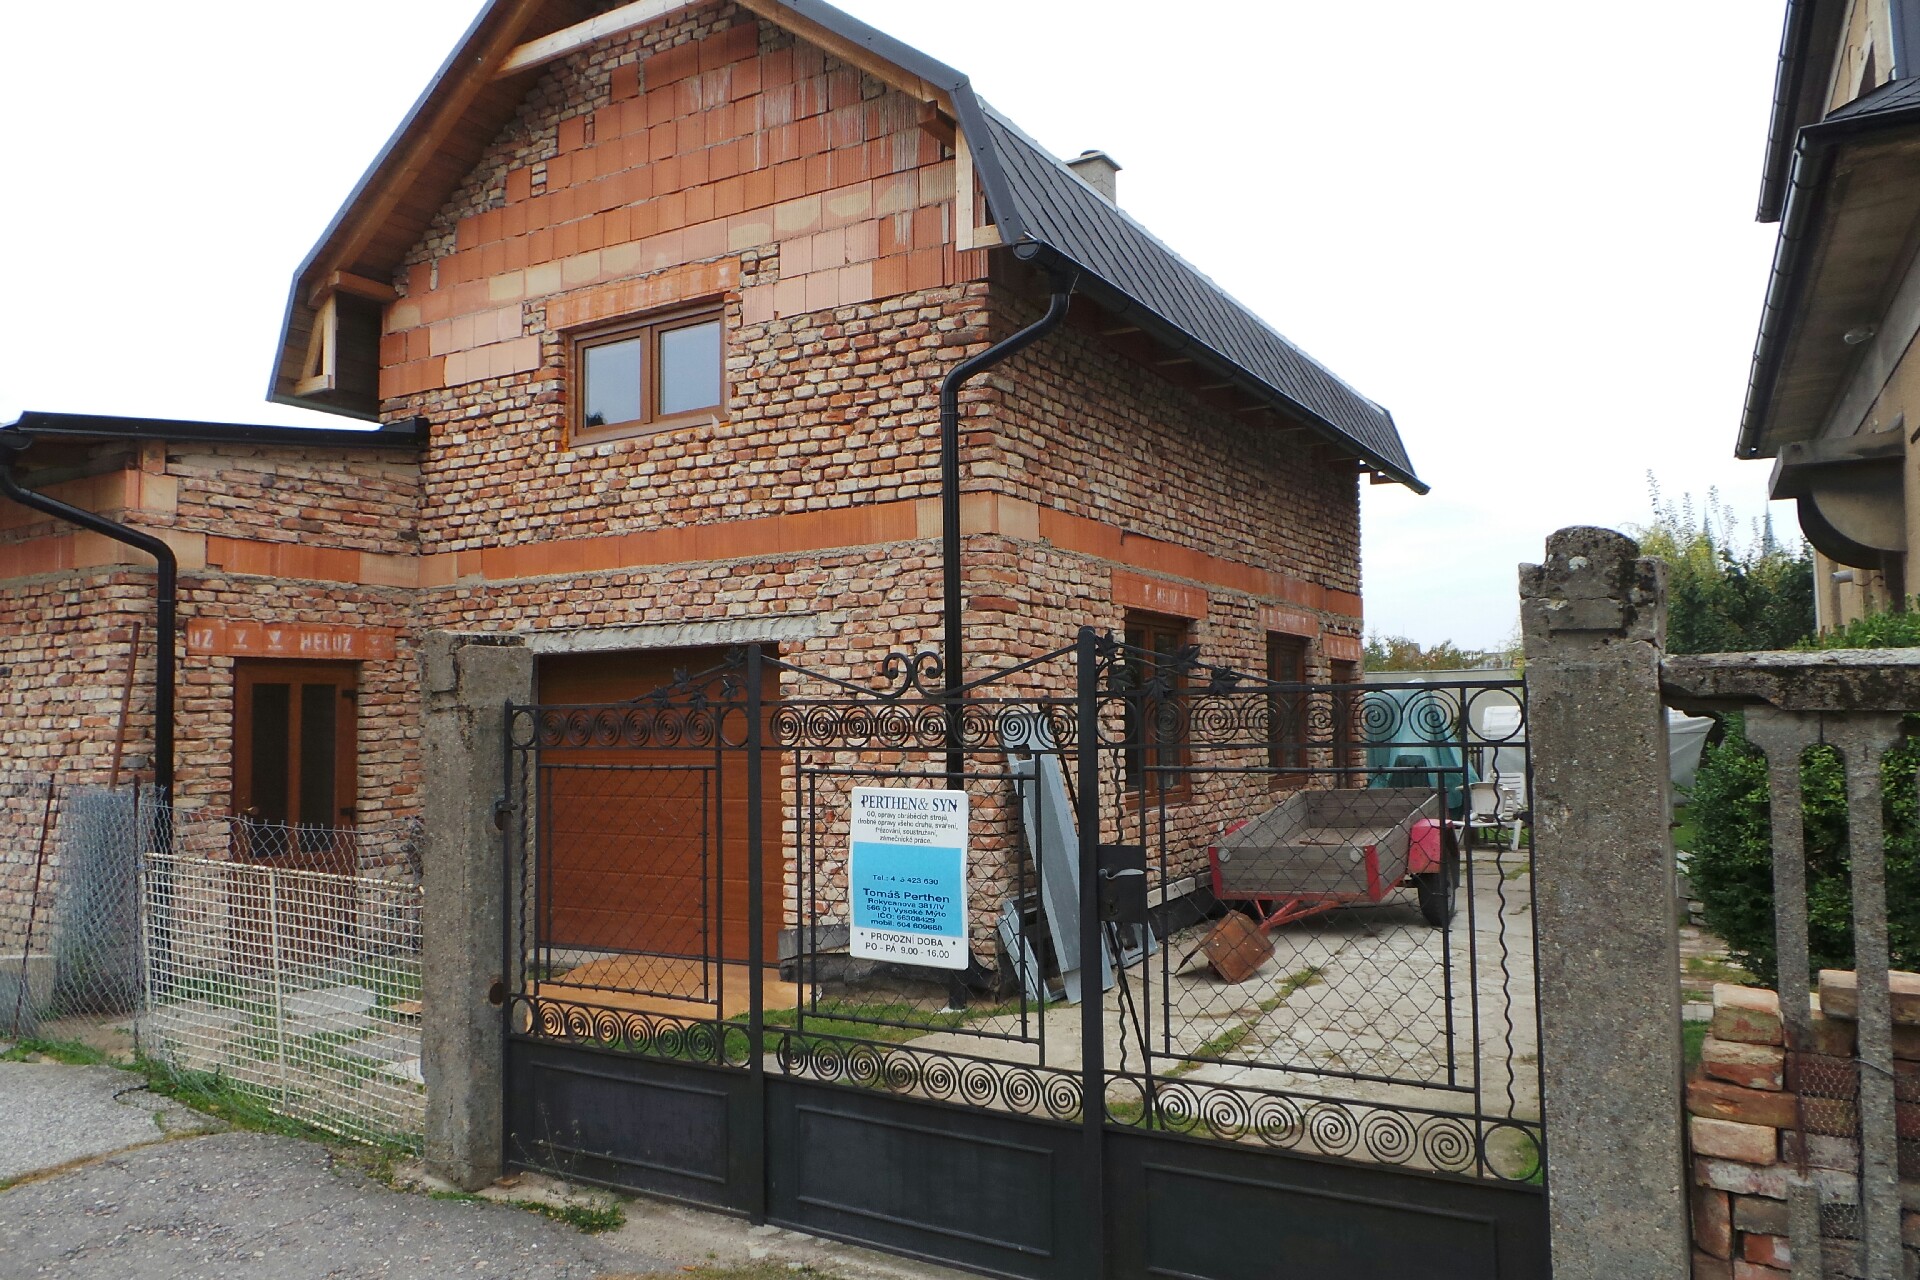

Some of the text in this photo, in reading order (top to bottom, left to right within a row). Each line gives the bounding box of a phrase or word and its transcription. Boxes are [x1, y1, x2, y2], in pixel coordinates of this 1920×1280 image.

[300, 631, 352, 652] HELUZ
[932, 797, 958, 812] SYN
[923, 878, 939, 886] 630
[863, 887, 950, 903] Tomáš Perthen
[867, 897, 945, 910] Rokycanova 381/IV
[893, 907, 923, 916] Vysoké
[925, 909, 947, 918] Mýto
[870, 919, 895, 927] mobil:
[870, 931, 943, 947] PROVOZNÍ DOBA
[865, 942, 878, 951] PO
[885, 943, 897, 953] PÁ
[900, 946, 919, 956] 9.00
[927, 949, 950, 959] 16.00
